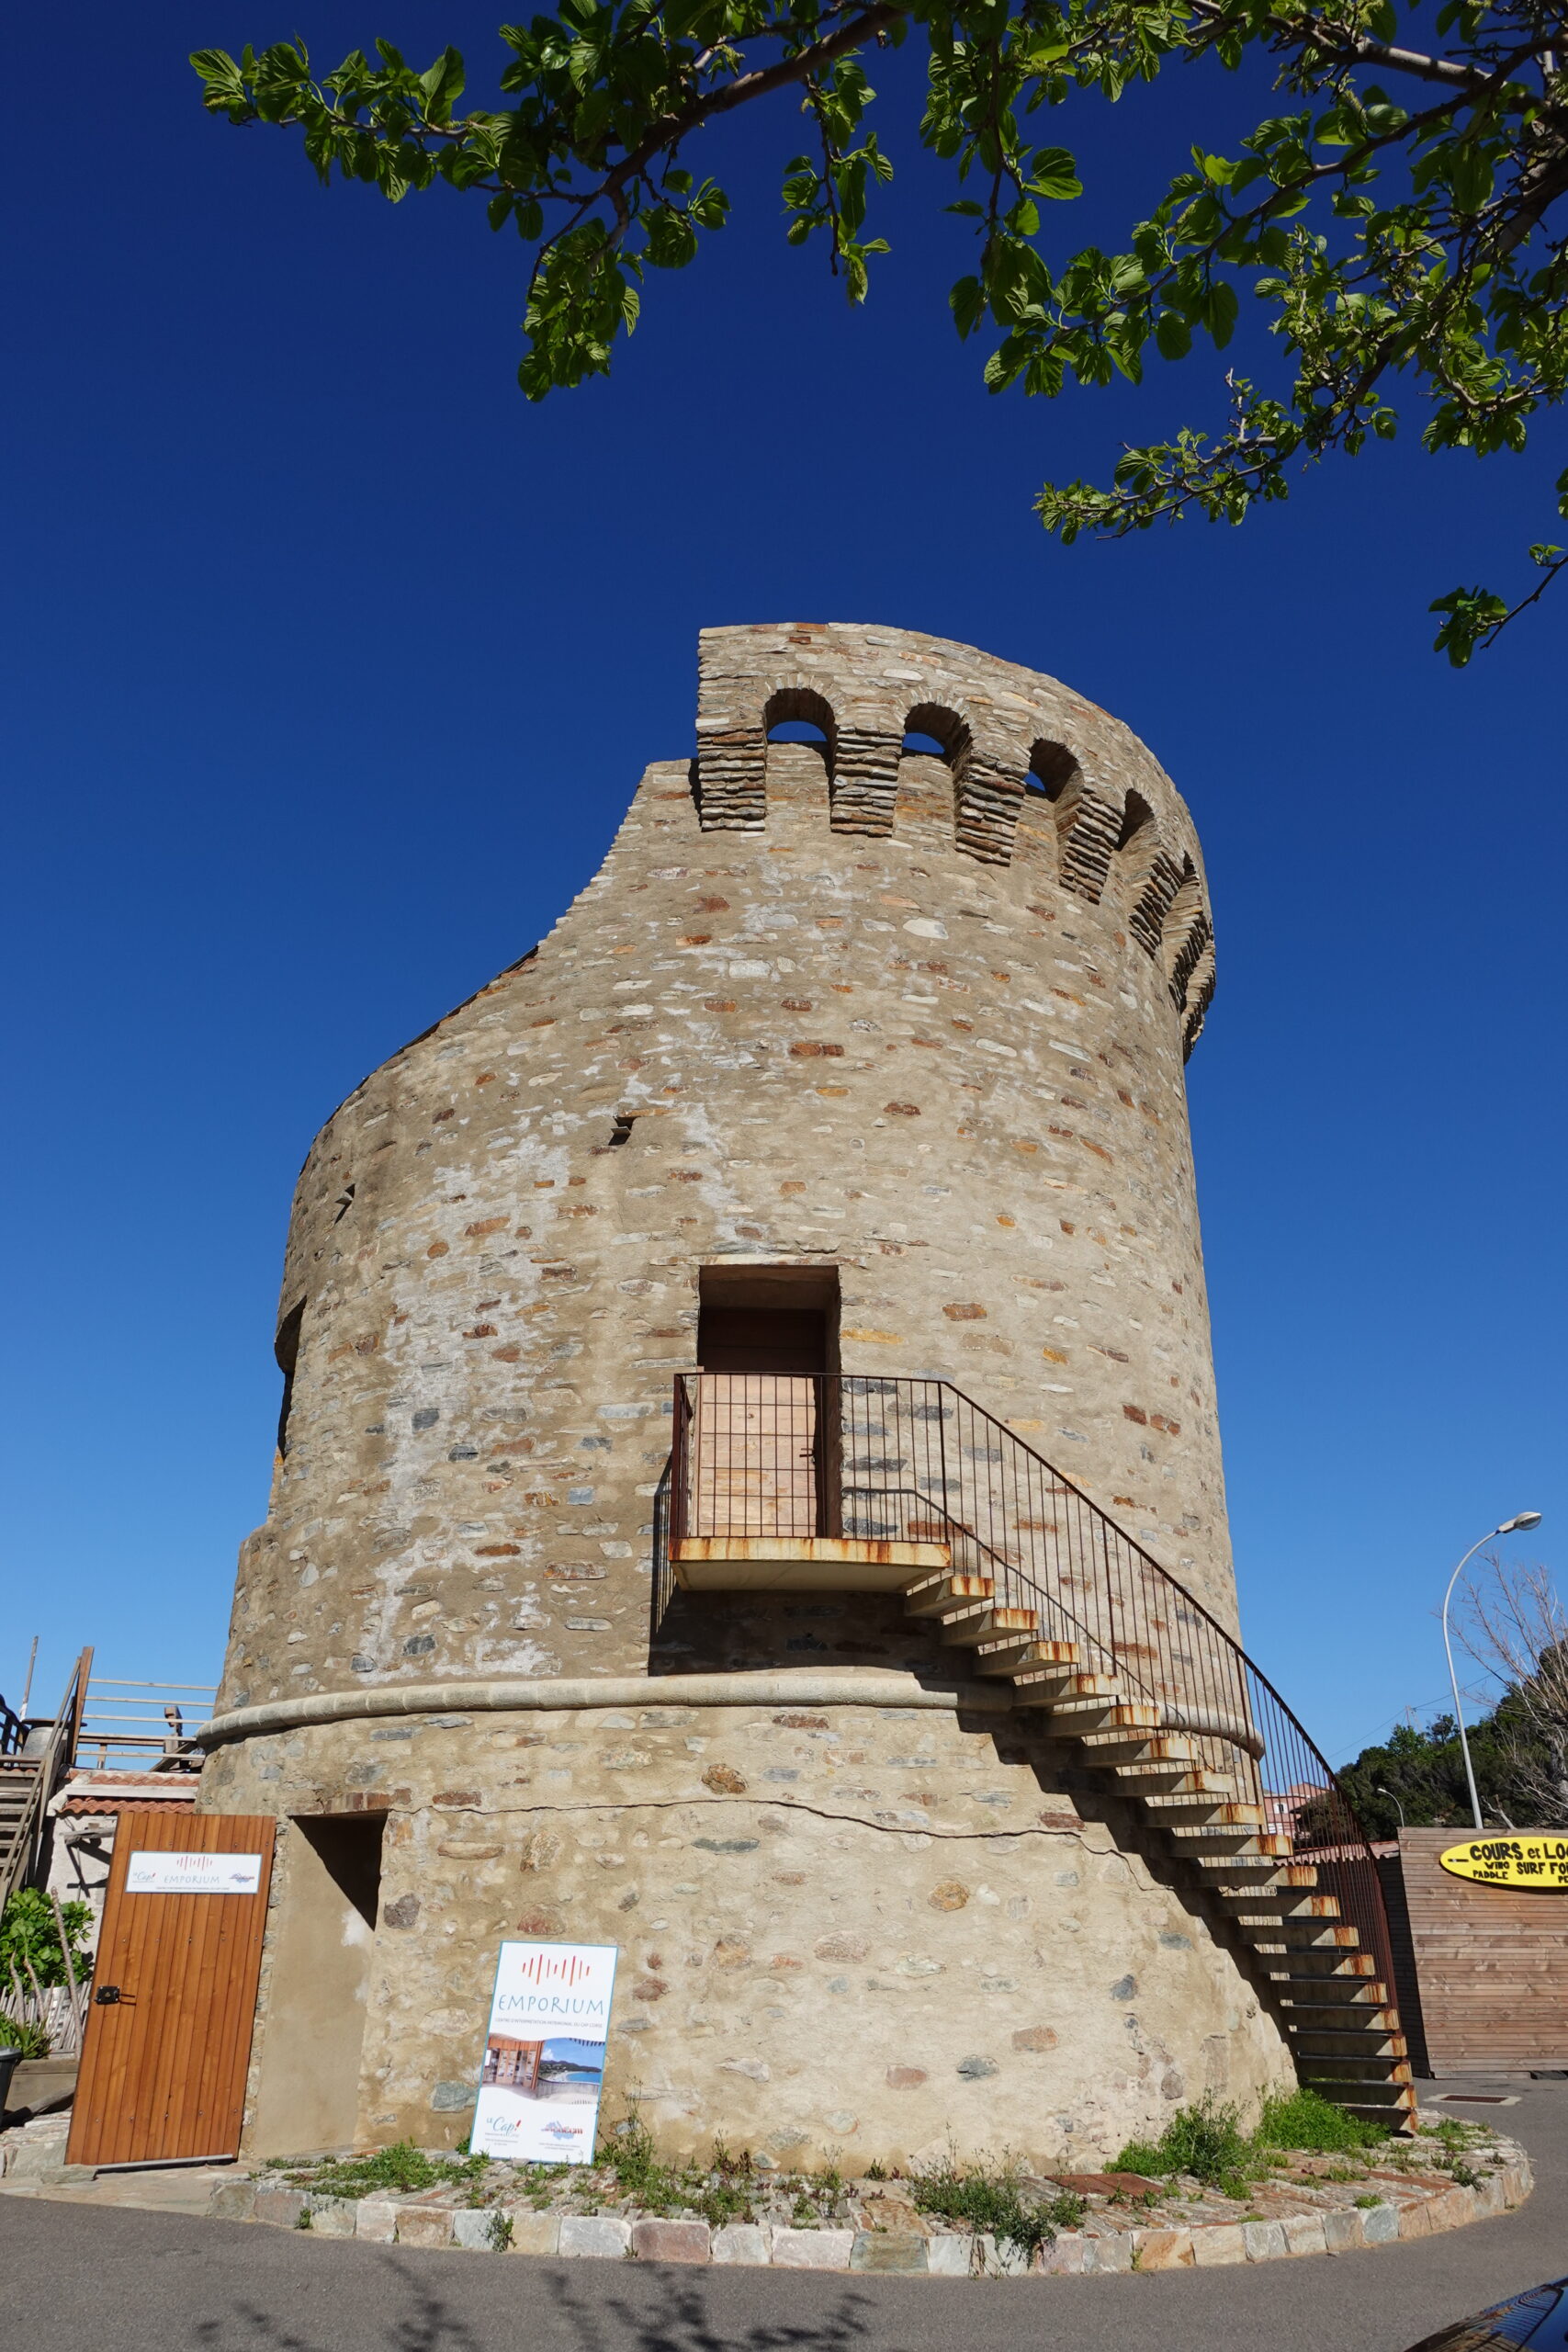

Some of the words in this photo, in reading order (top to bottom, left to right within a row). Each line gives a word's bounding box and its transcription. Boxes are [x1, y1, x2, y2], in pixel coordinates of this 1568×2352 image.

[1470, 1841, 1523, 1860] COURS
[1528, 1847, 1541, 1859] et
[1472, 1870, 1508, 1880] PADDLE
[1517, 1862, 1546, 1875] SURF
[164, 1874, 220, 1884] EMPORIUM
[498, 1994, 604, 2015] EMPORIUM
